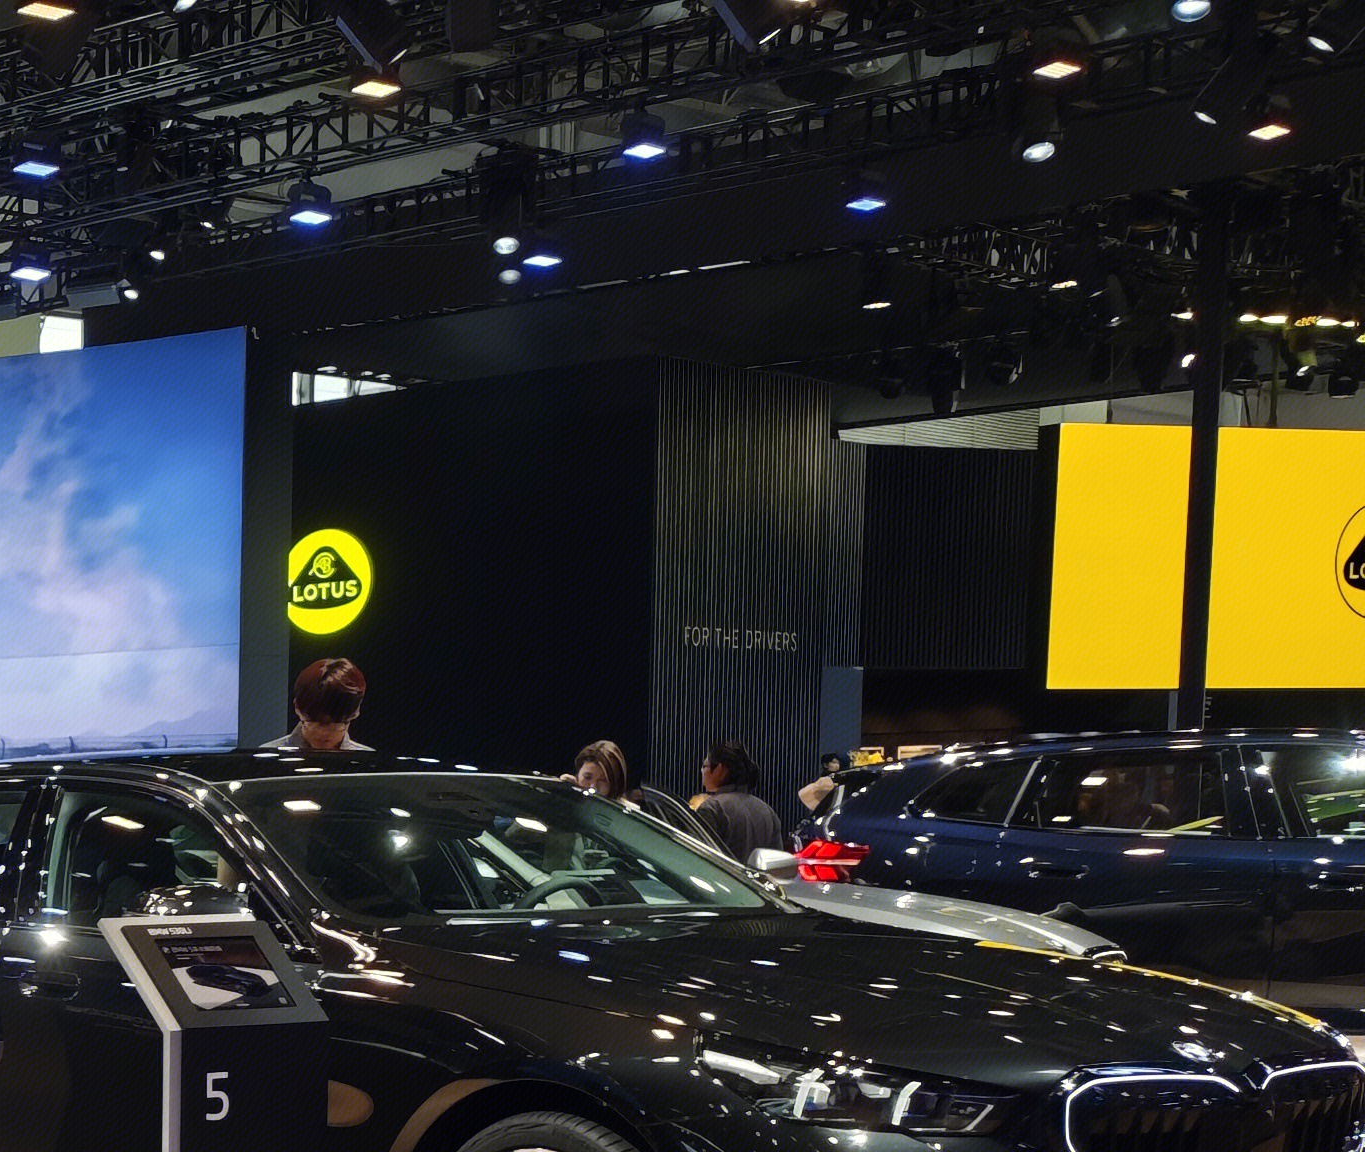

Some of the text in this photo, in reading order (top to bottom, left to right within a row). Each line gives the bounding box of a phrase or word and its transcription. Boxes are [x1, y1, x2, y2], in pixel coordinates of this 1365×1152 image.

[292, 580, 358, 602] LOTUS
[684, 626, 797, 652] FOR THE DRIVERS
[205, 1071, 230, 1121] 5
